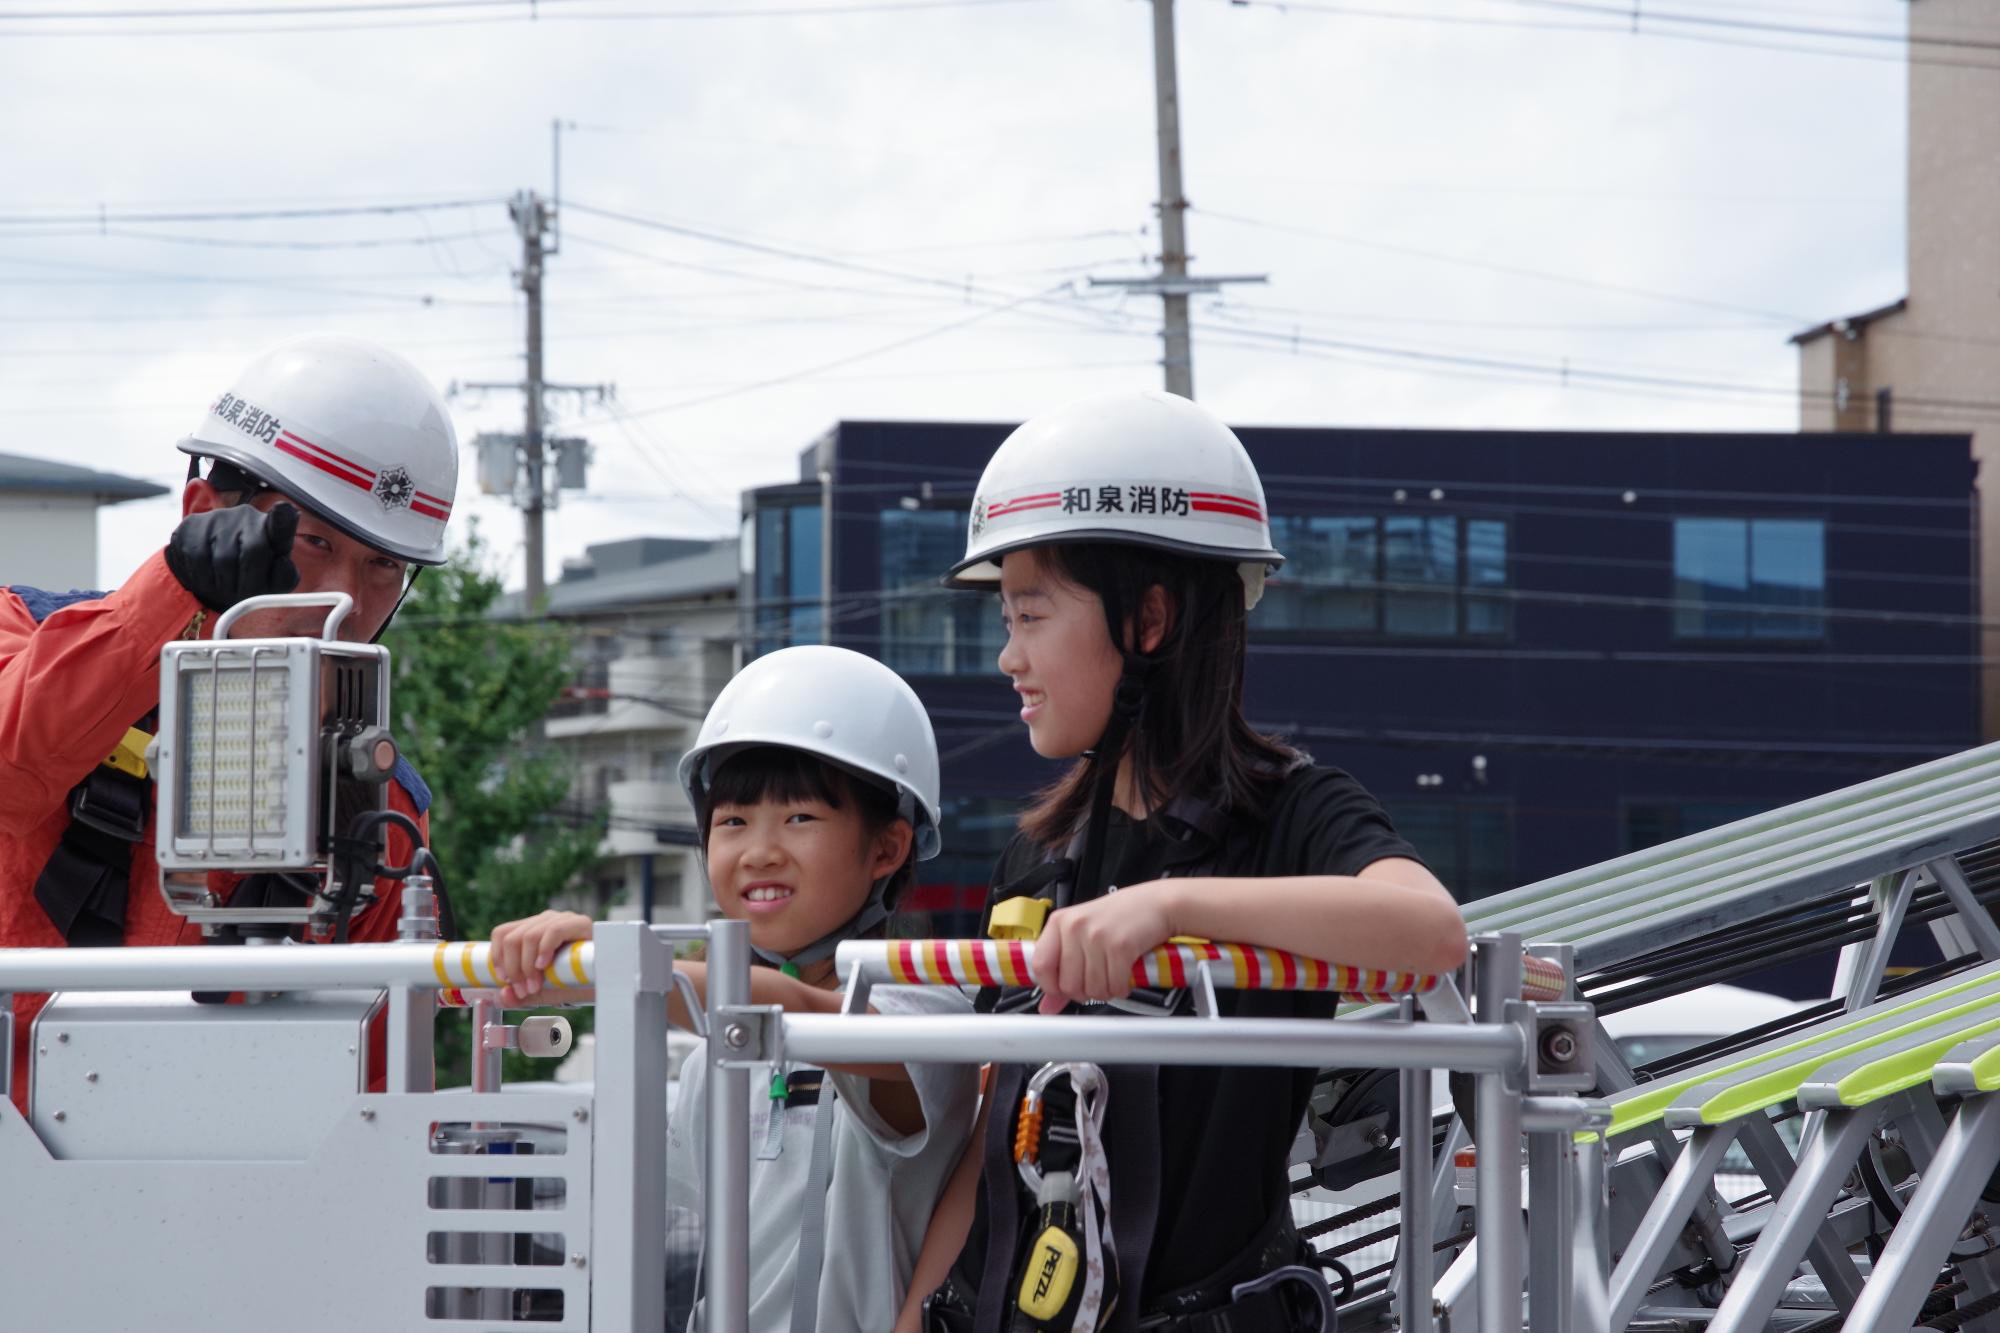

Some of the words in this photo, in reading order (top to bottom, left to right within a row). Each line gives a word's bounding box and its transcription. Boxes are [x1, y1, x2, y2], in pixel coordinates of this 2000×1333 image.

[214, 392, 281, 444] 和泉消防
[1062, 485, 1190, 516] 和泉消防
[1032, 1245, 1063, 1304] PETZL
